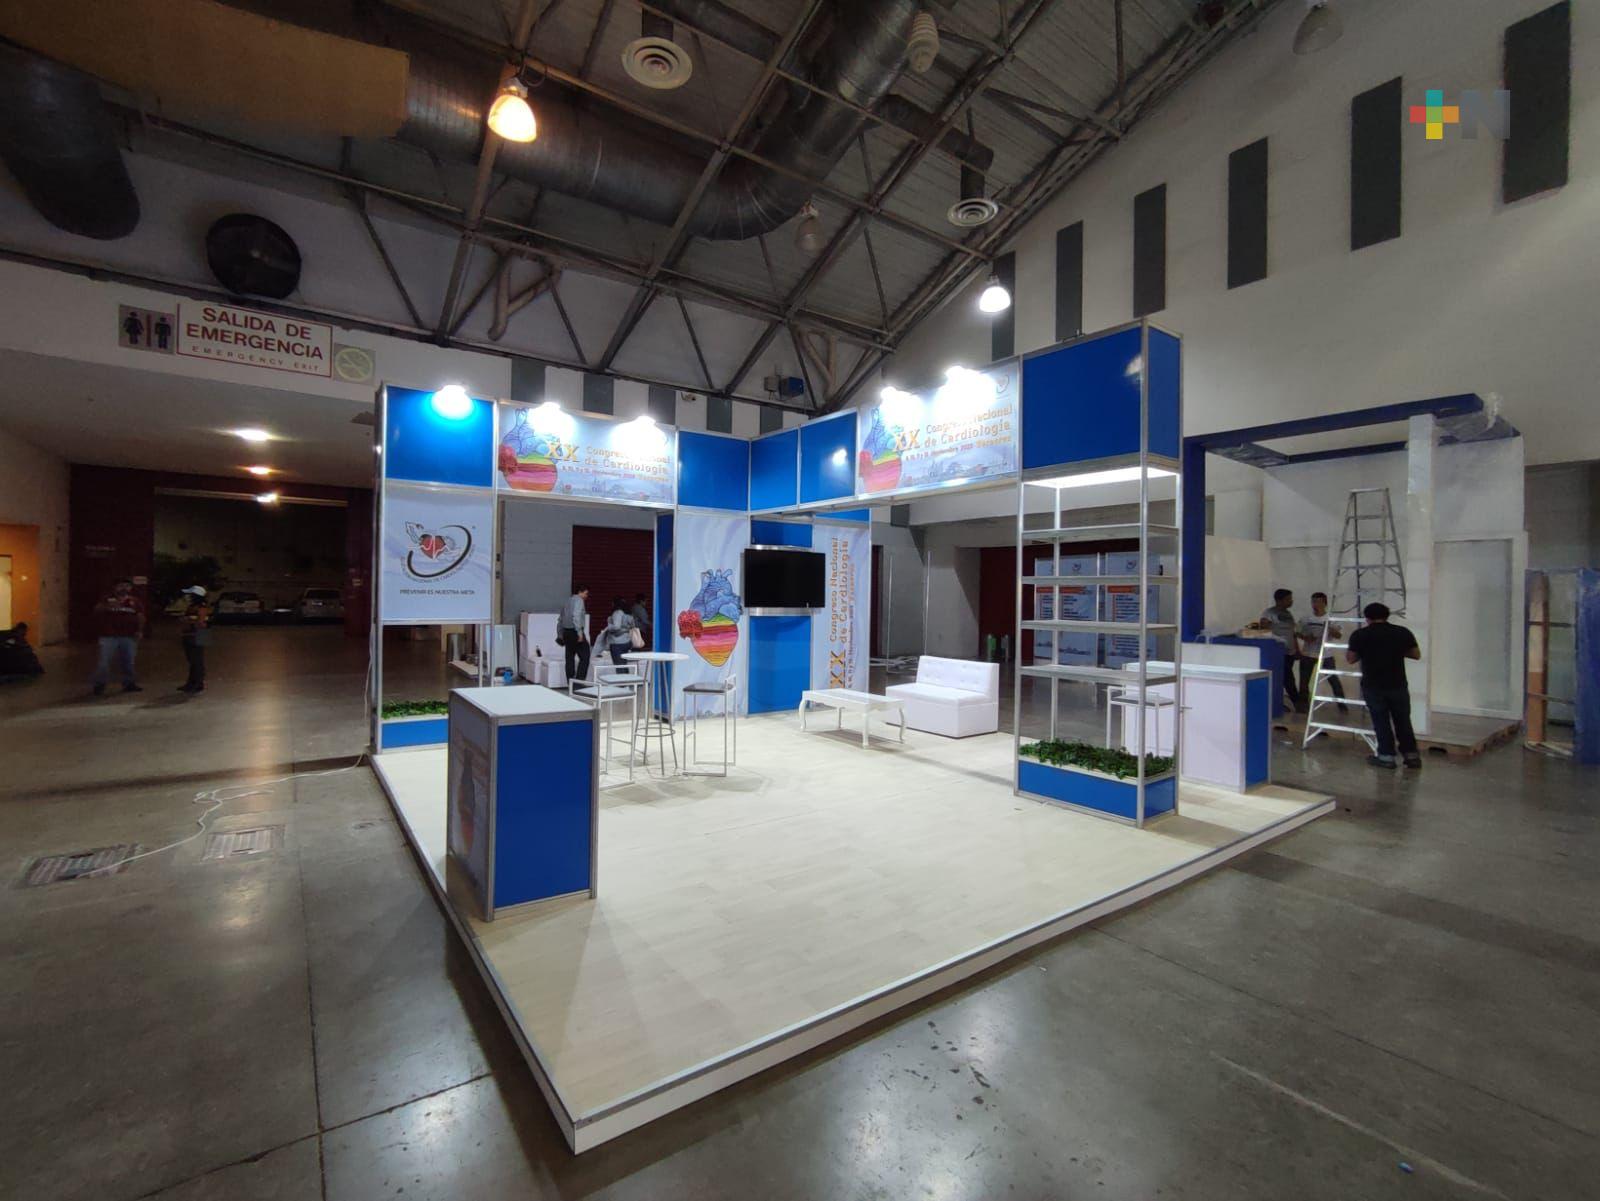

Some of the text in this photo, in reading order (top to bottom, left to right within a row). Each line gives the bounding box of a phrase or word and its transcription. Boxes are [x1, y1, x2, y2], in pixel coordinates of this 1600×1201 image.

[202, 307, 311, 340] SALIDA DE
[186, 323, 324, 360] EMERGENCIA
[192, 345, 320, 371] EMERGENCY EXIT
[544, 440, 581, 463] XX
[925, 436, 937, 448] de
[585, 456, 598, 466] de
[829, 537, 838, 642] Congreso Nacional
[839, 626, 847, 643] de
[830, 650, 846, 688] XX
